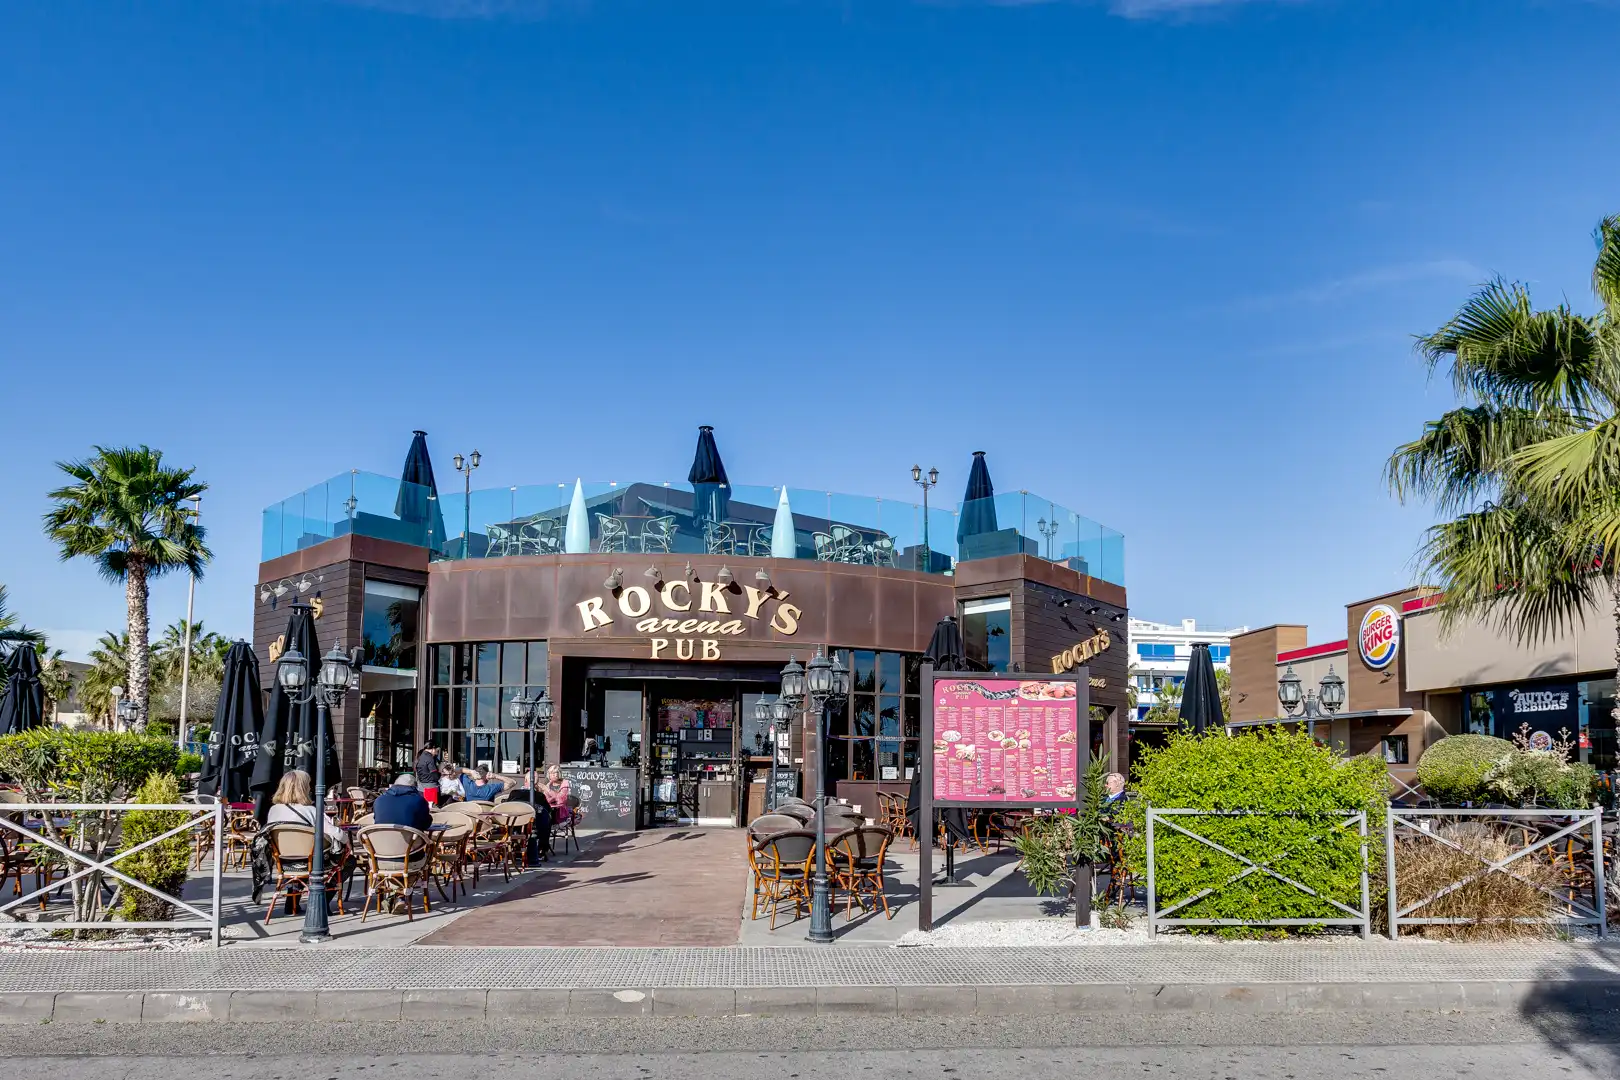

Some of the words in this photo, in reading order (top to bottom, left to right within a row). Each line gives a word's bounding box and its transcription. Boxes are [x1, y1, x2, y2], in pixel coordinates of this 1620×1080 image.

[576, 580, 802, 636] ROCKY'S
[635, 617, 746, 635] arena
[1363, 614, 1391, 641] BURGER
[650, 638, 721, 660] PUB
[1364, 624, 1393, 656] KING
[1513, 699, 1568, 713] BEBIDAS
[1517, 691, 1553, 703] AUTO
[597, 781, 619, 790] Happy
